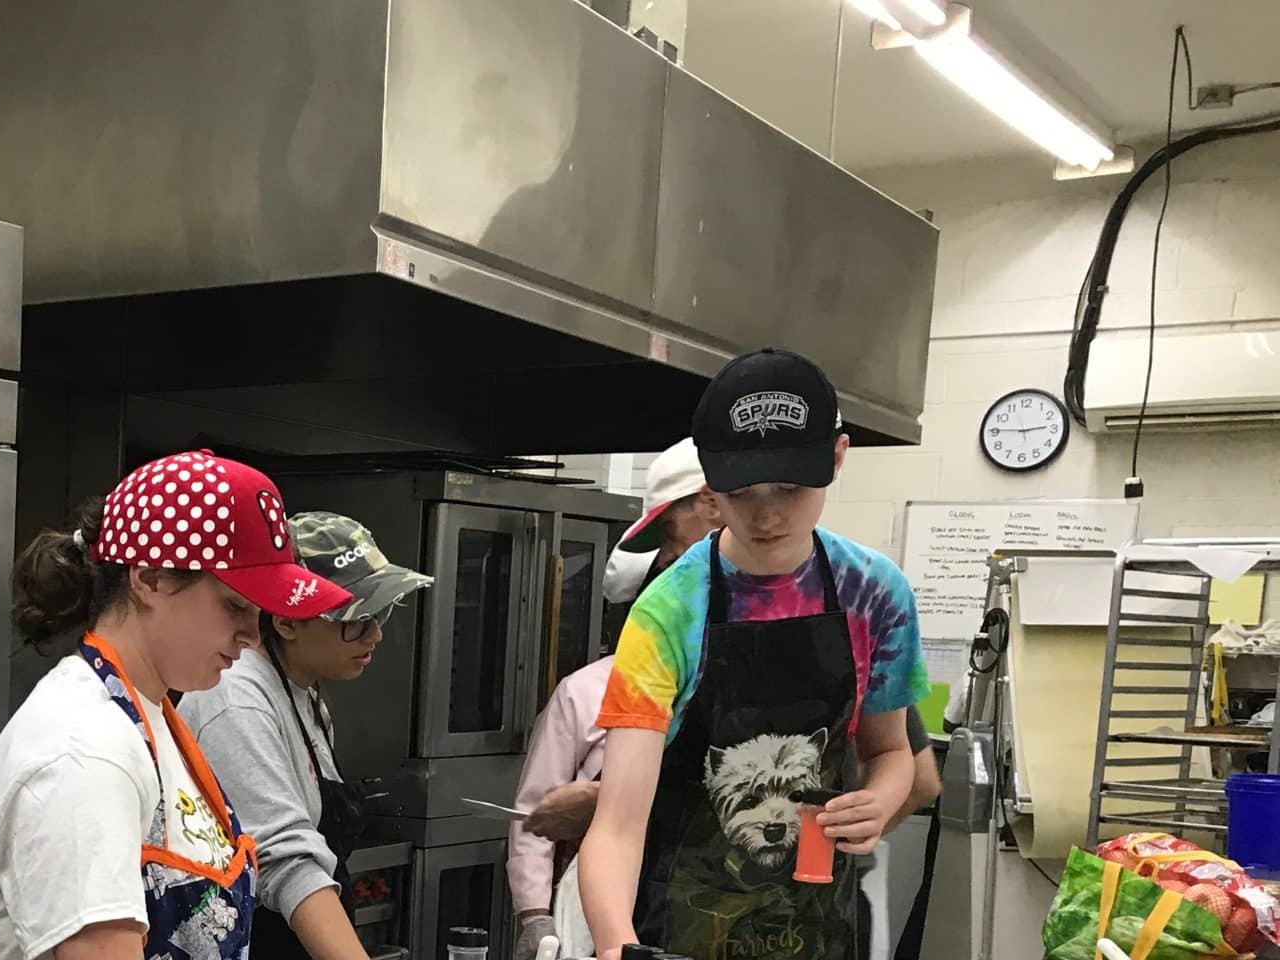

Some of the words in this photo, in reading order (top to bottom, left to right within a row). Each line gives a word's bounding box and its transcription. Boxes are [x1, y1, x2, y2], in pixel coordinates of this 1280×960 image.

[1008, 403, 1016, 413] 11
[1021, 399, 1032, 408] 12
[738, 403, 802, 422] SPURS
[1046, 410, 1054, 421] 2
[997, 413, 1009, 423] 10
[1050, 423, 1058, 434] 3
[994, 440, 1002, 450] 8
[1044, 438, 1052, 447] 4
[1005, 449, 1012, 459] 7
[1017, 452, 1026, 462] 6
[1032, 448, 1040, 458] 5
